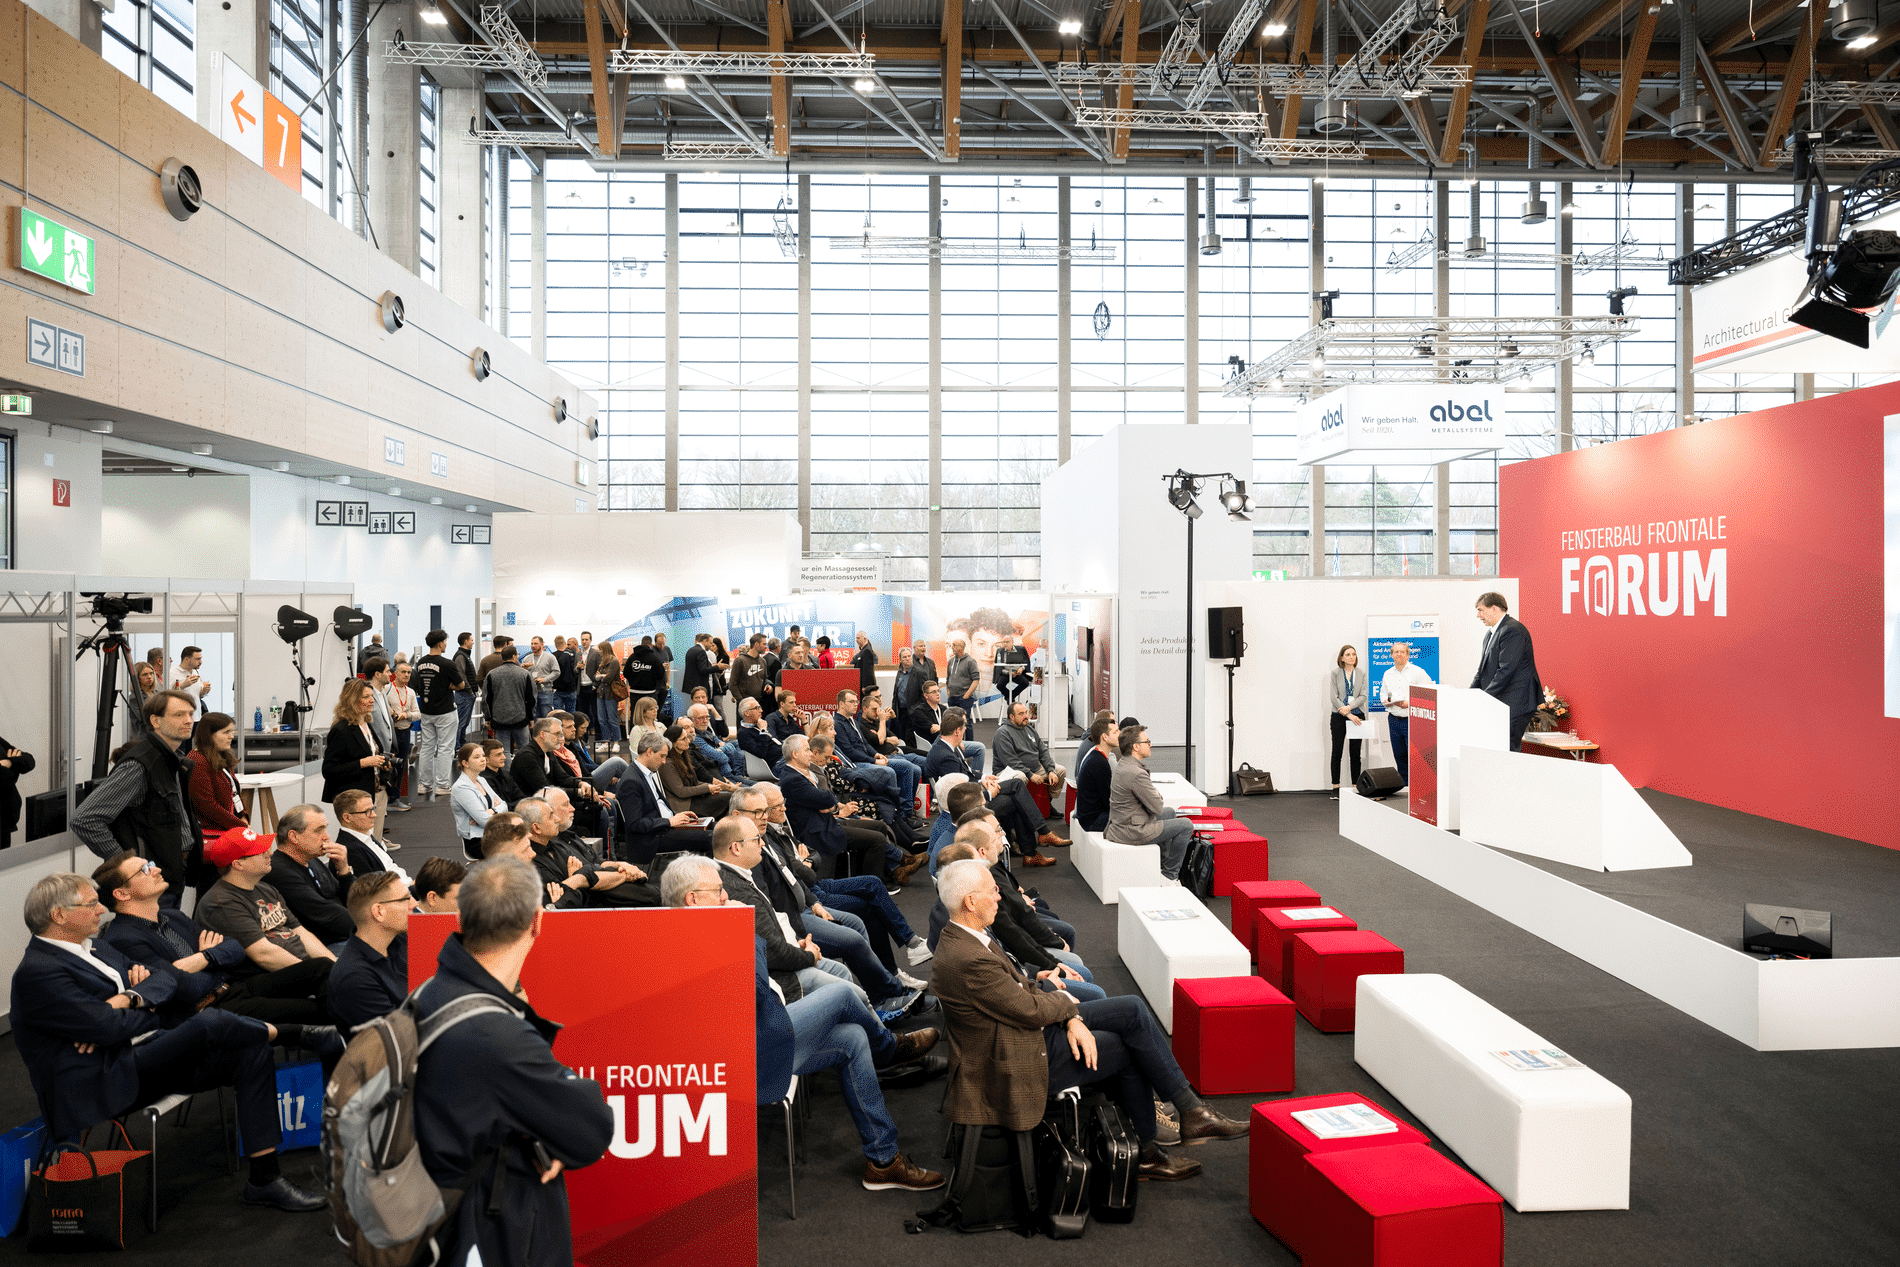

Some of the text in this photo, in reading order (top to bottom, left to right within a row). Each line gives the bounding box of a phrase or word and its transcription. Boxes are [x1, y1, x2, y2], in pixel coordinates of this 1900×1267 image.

[277, 113, 289, 168] 7
[1703, 311, 1778, 349] Architectural
[1321, 403, 1344, 432] abel
[1376, 416, 1400, 425] geben
[1430, 400, 1494, 422] abel
[1561, 515, 1727, 551] FENSTERBAU FRONTALE
[824, 565, 877, 573] Massagesessel:
[1561, 548, 1727, 617] FORUM
[730, 604, 813, 629] ZUKUNFT
[1140, 636, 1160, 645] Jedes
[606, 1062, 727, 1088] FRONTALE
